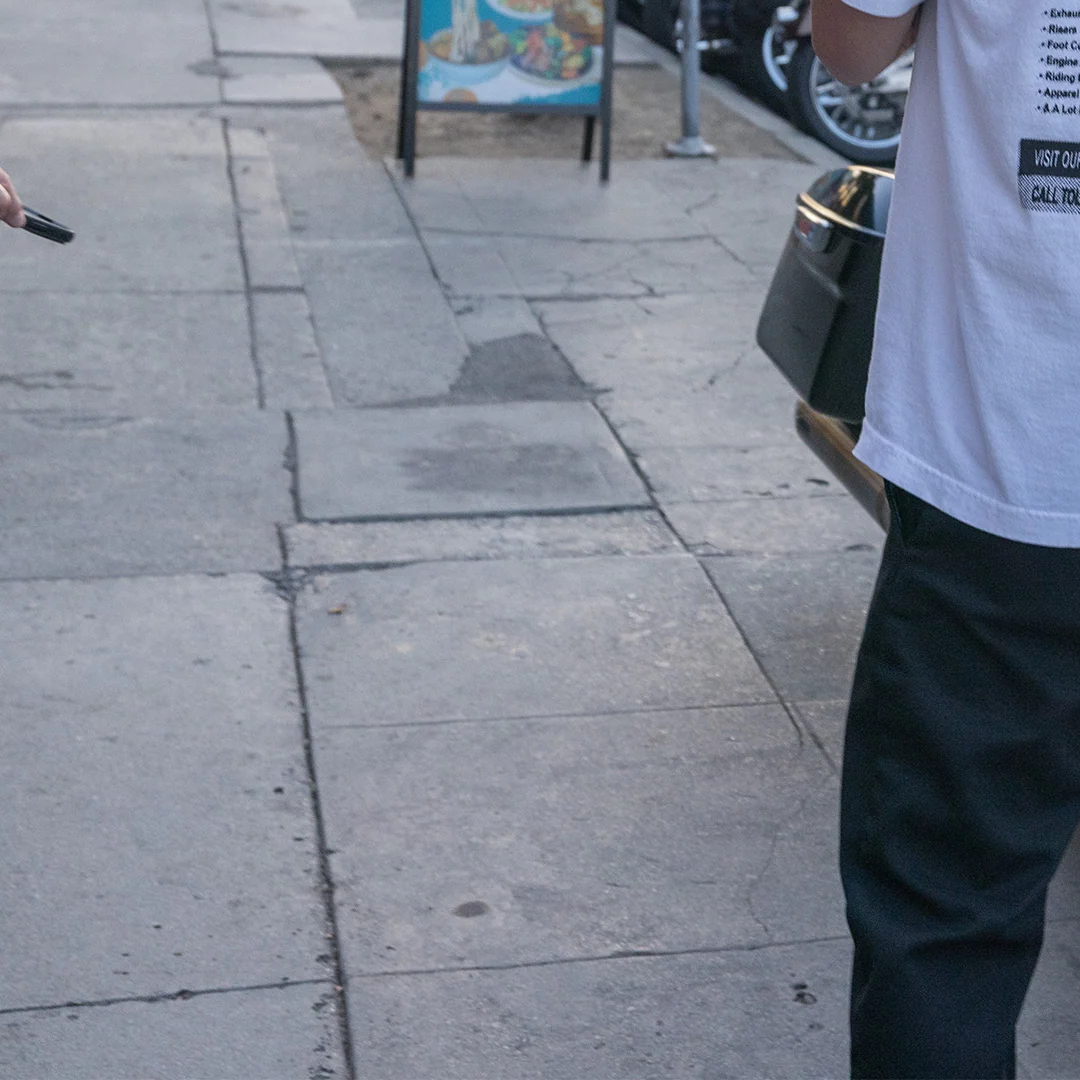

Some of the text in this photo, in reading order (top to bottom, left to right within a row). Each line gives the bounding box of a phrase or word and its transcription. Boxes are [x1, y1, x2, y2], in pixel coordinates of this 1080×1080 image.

[1048, 24, 1077, 34] Risers
[1047, 40, 1068, 50] Foot
[1046, 55, 1078, 68] Engine
[1045, 71, 1075, 84] Riding
[1043, 87, 1080, 99] Apparel
[1061, 104, 1077, 114] Lot
[1034, 149, 1060, 168] VISIT
[1031, 186, 1058, 204] CALL
